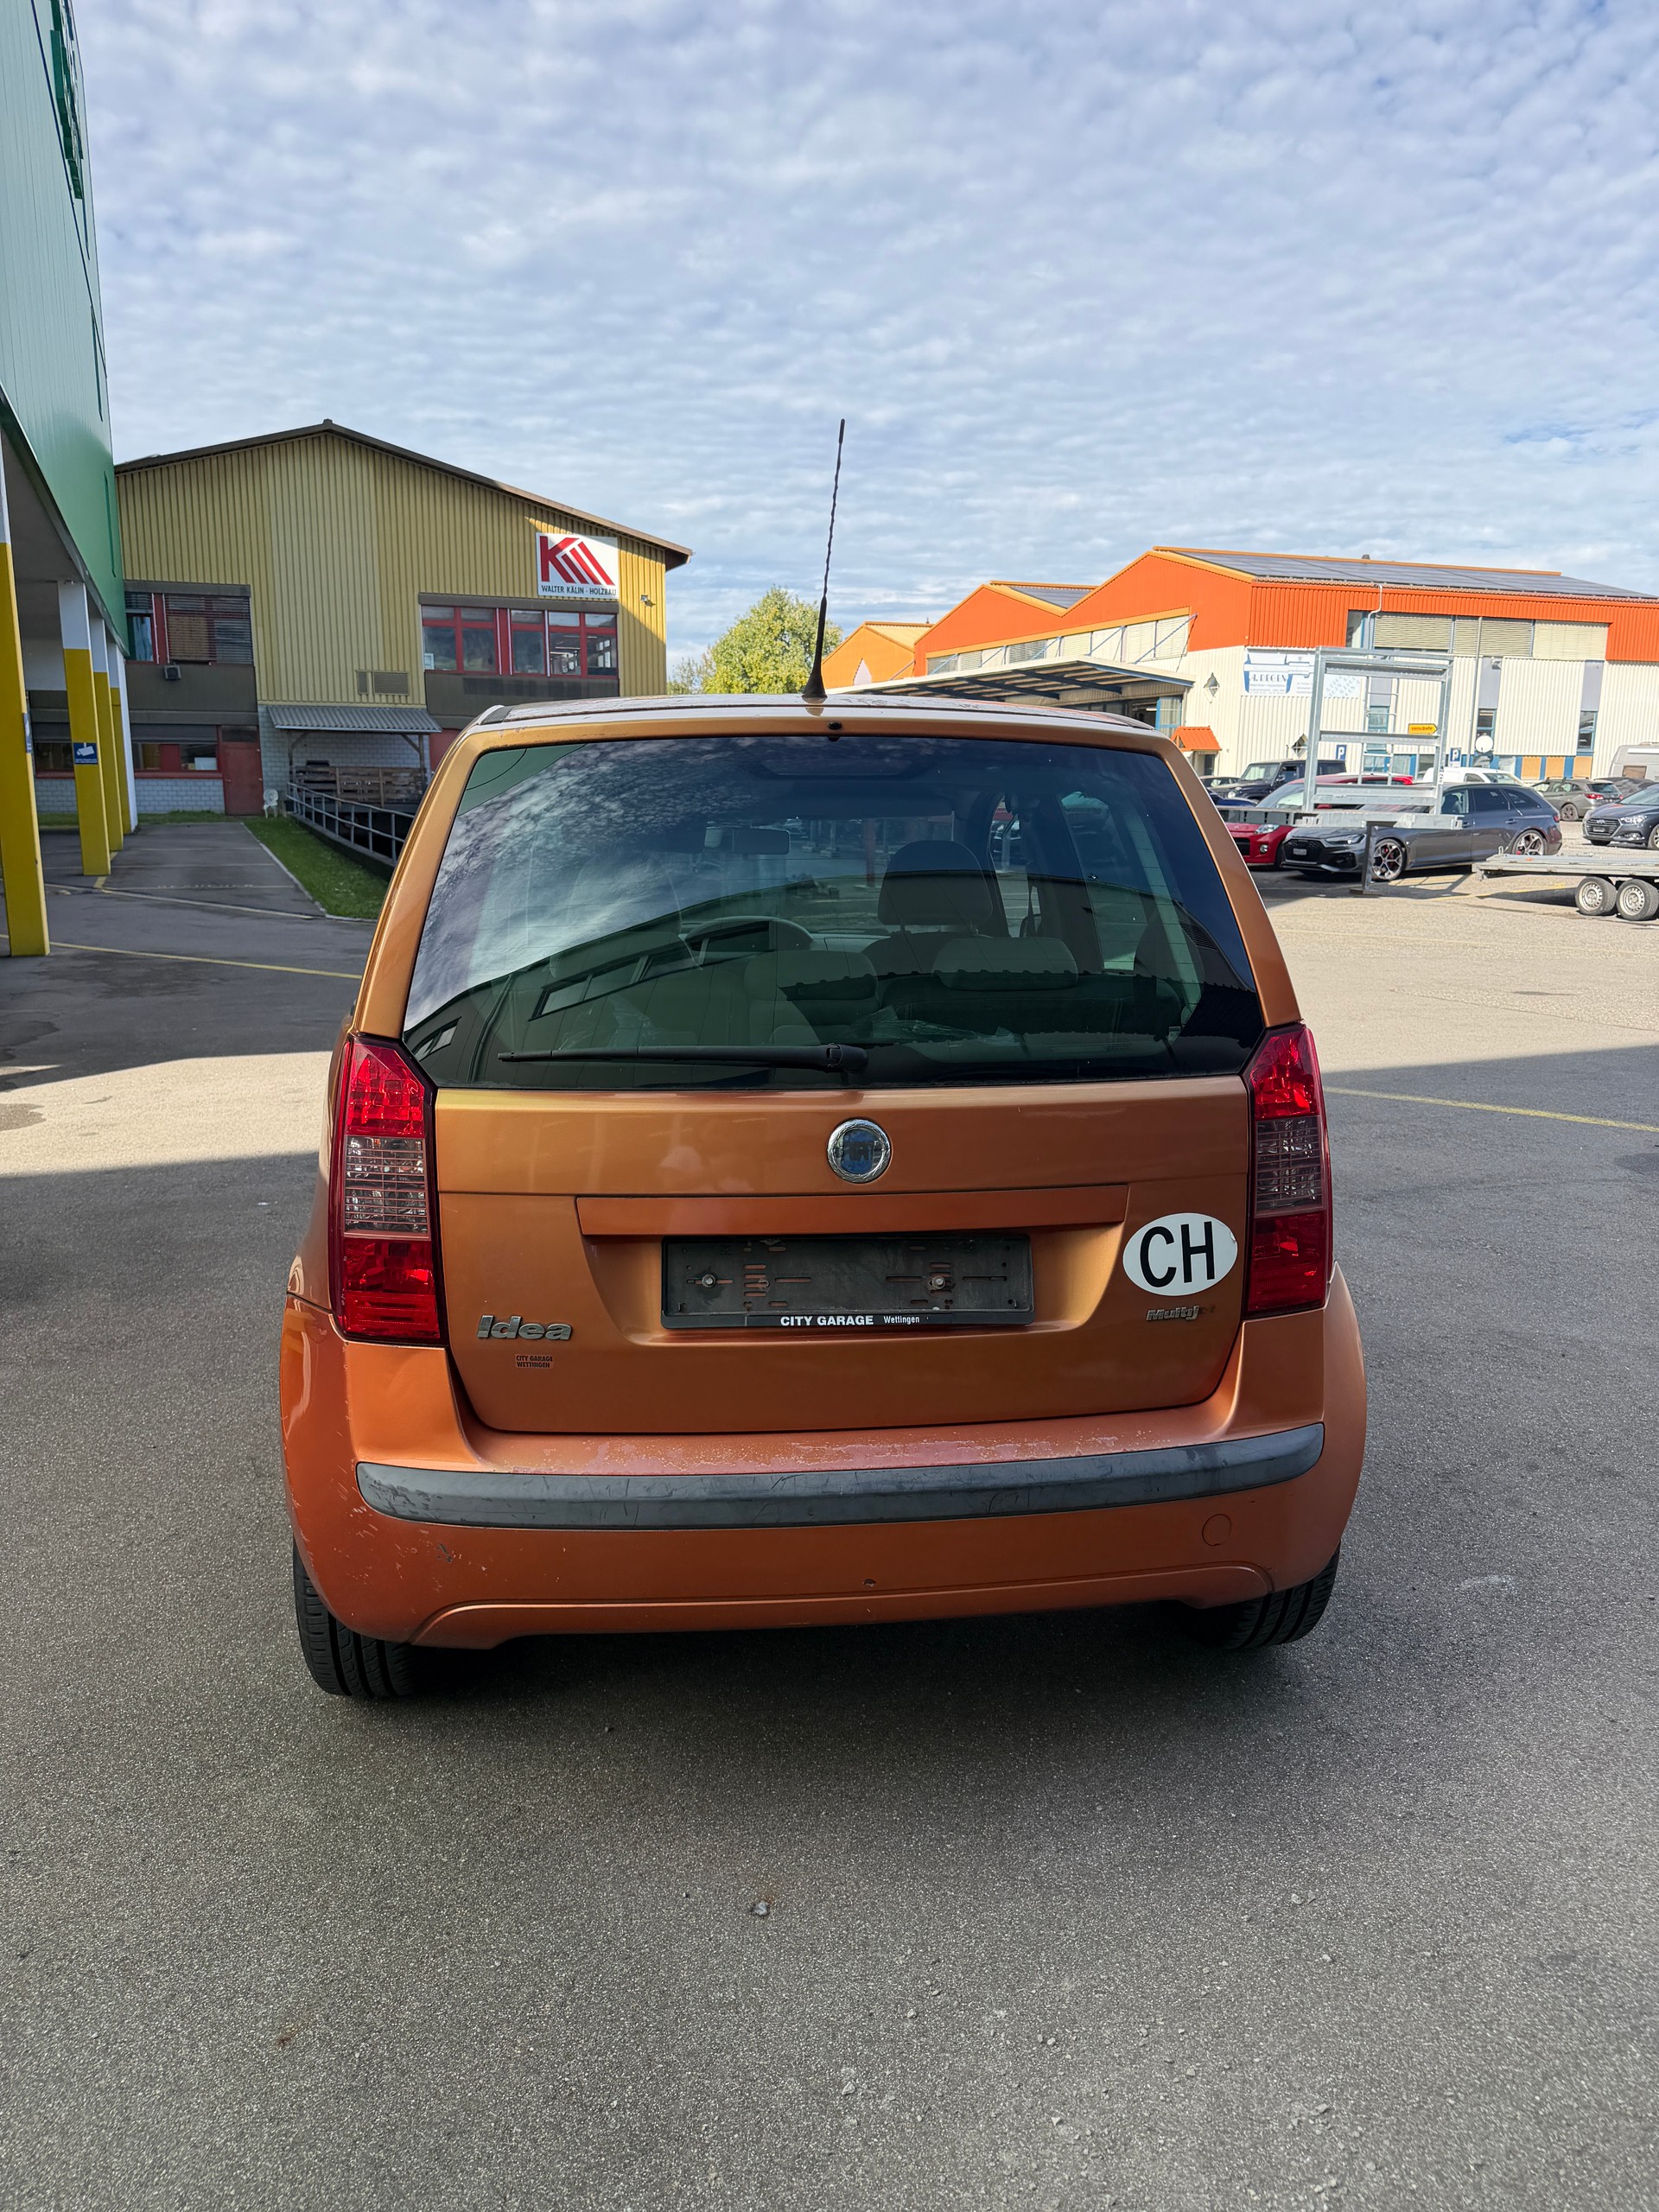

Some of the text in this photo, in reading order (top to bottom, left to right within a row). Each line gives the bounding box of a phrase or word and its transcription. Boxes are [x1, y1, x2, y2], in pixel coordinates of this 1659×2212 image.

[567, 585, 584, 594] KÄLIN
[589, 588, 617, 596] HOLZBAU
[1140, 1221, 1215, 1287] CH
[477, 1314, 572, 1341] Idea
[780, 1315, 920, 1326] CITY GARAGE Wettingen
